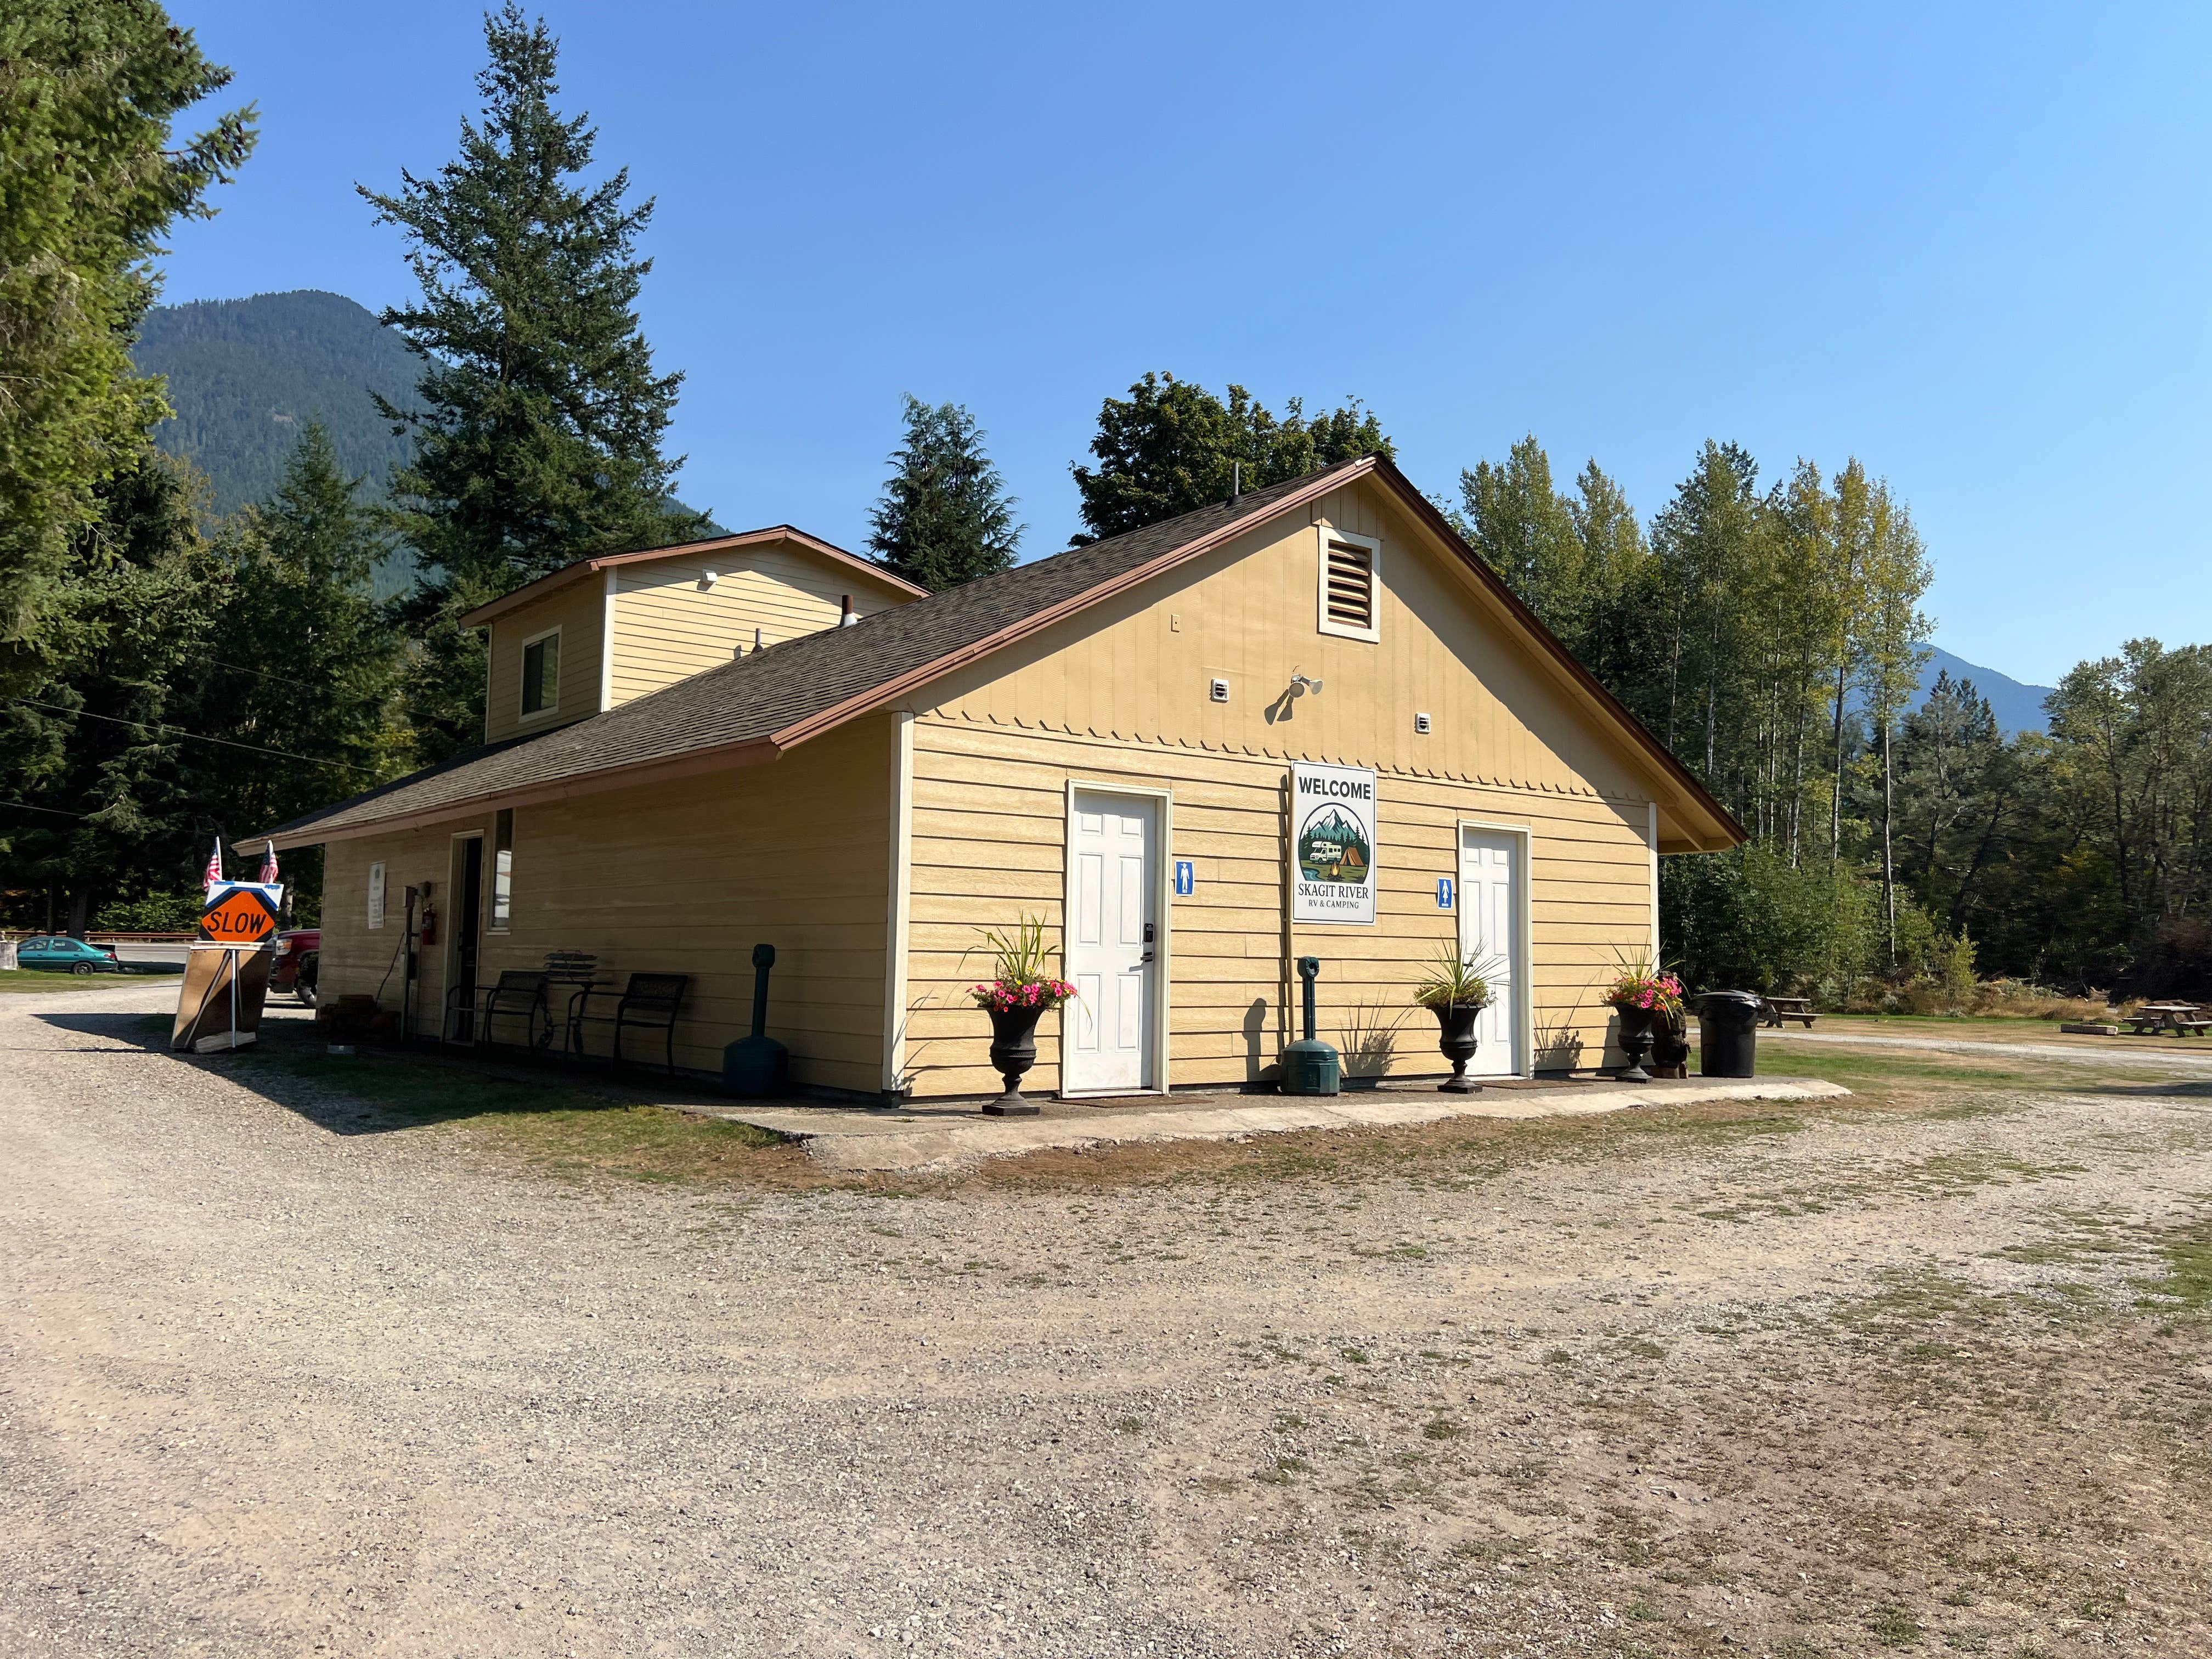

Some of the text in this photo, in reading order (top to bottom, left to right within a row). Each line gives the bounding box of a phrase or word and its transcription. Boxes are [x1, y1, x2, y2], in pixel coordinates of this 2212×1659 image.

[1299, 776, 1370, 800] WELCOME
[1298, 883, 1369, 899] SKAGIT RIVER
[1326, 900, 1359, 909] CAMPING
[207, 911, 266, 934] SLOW
